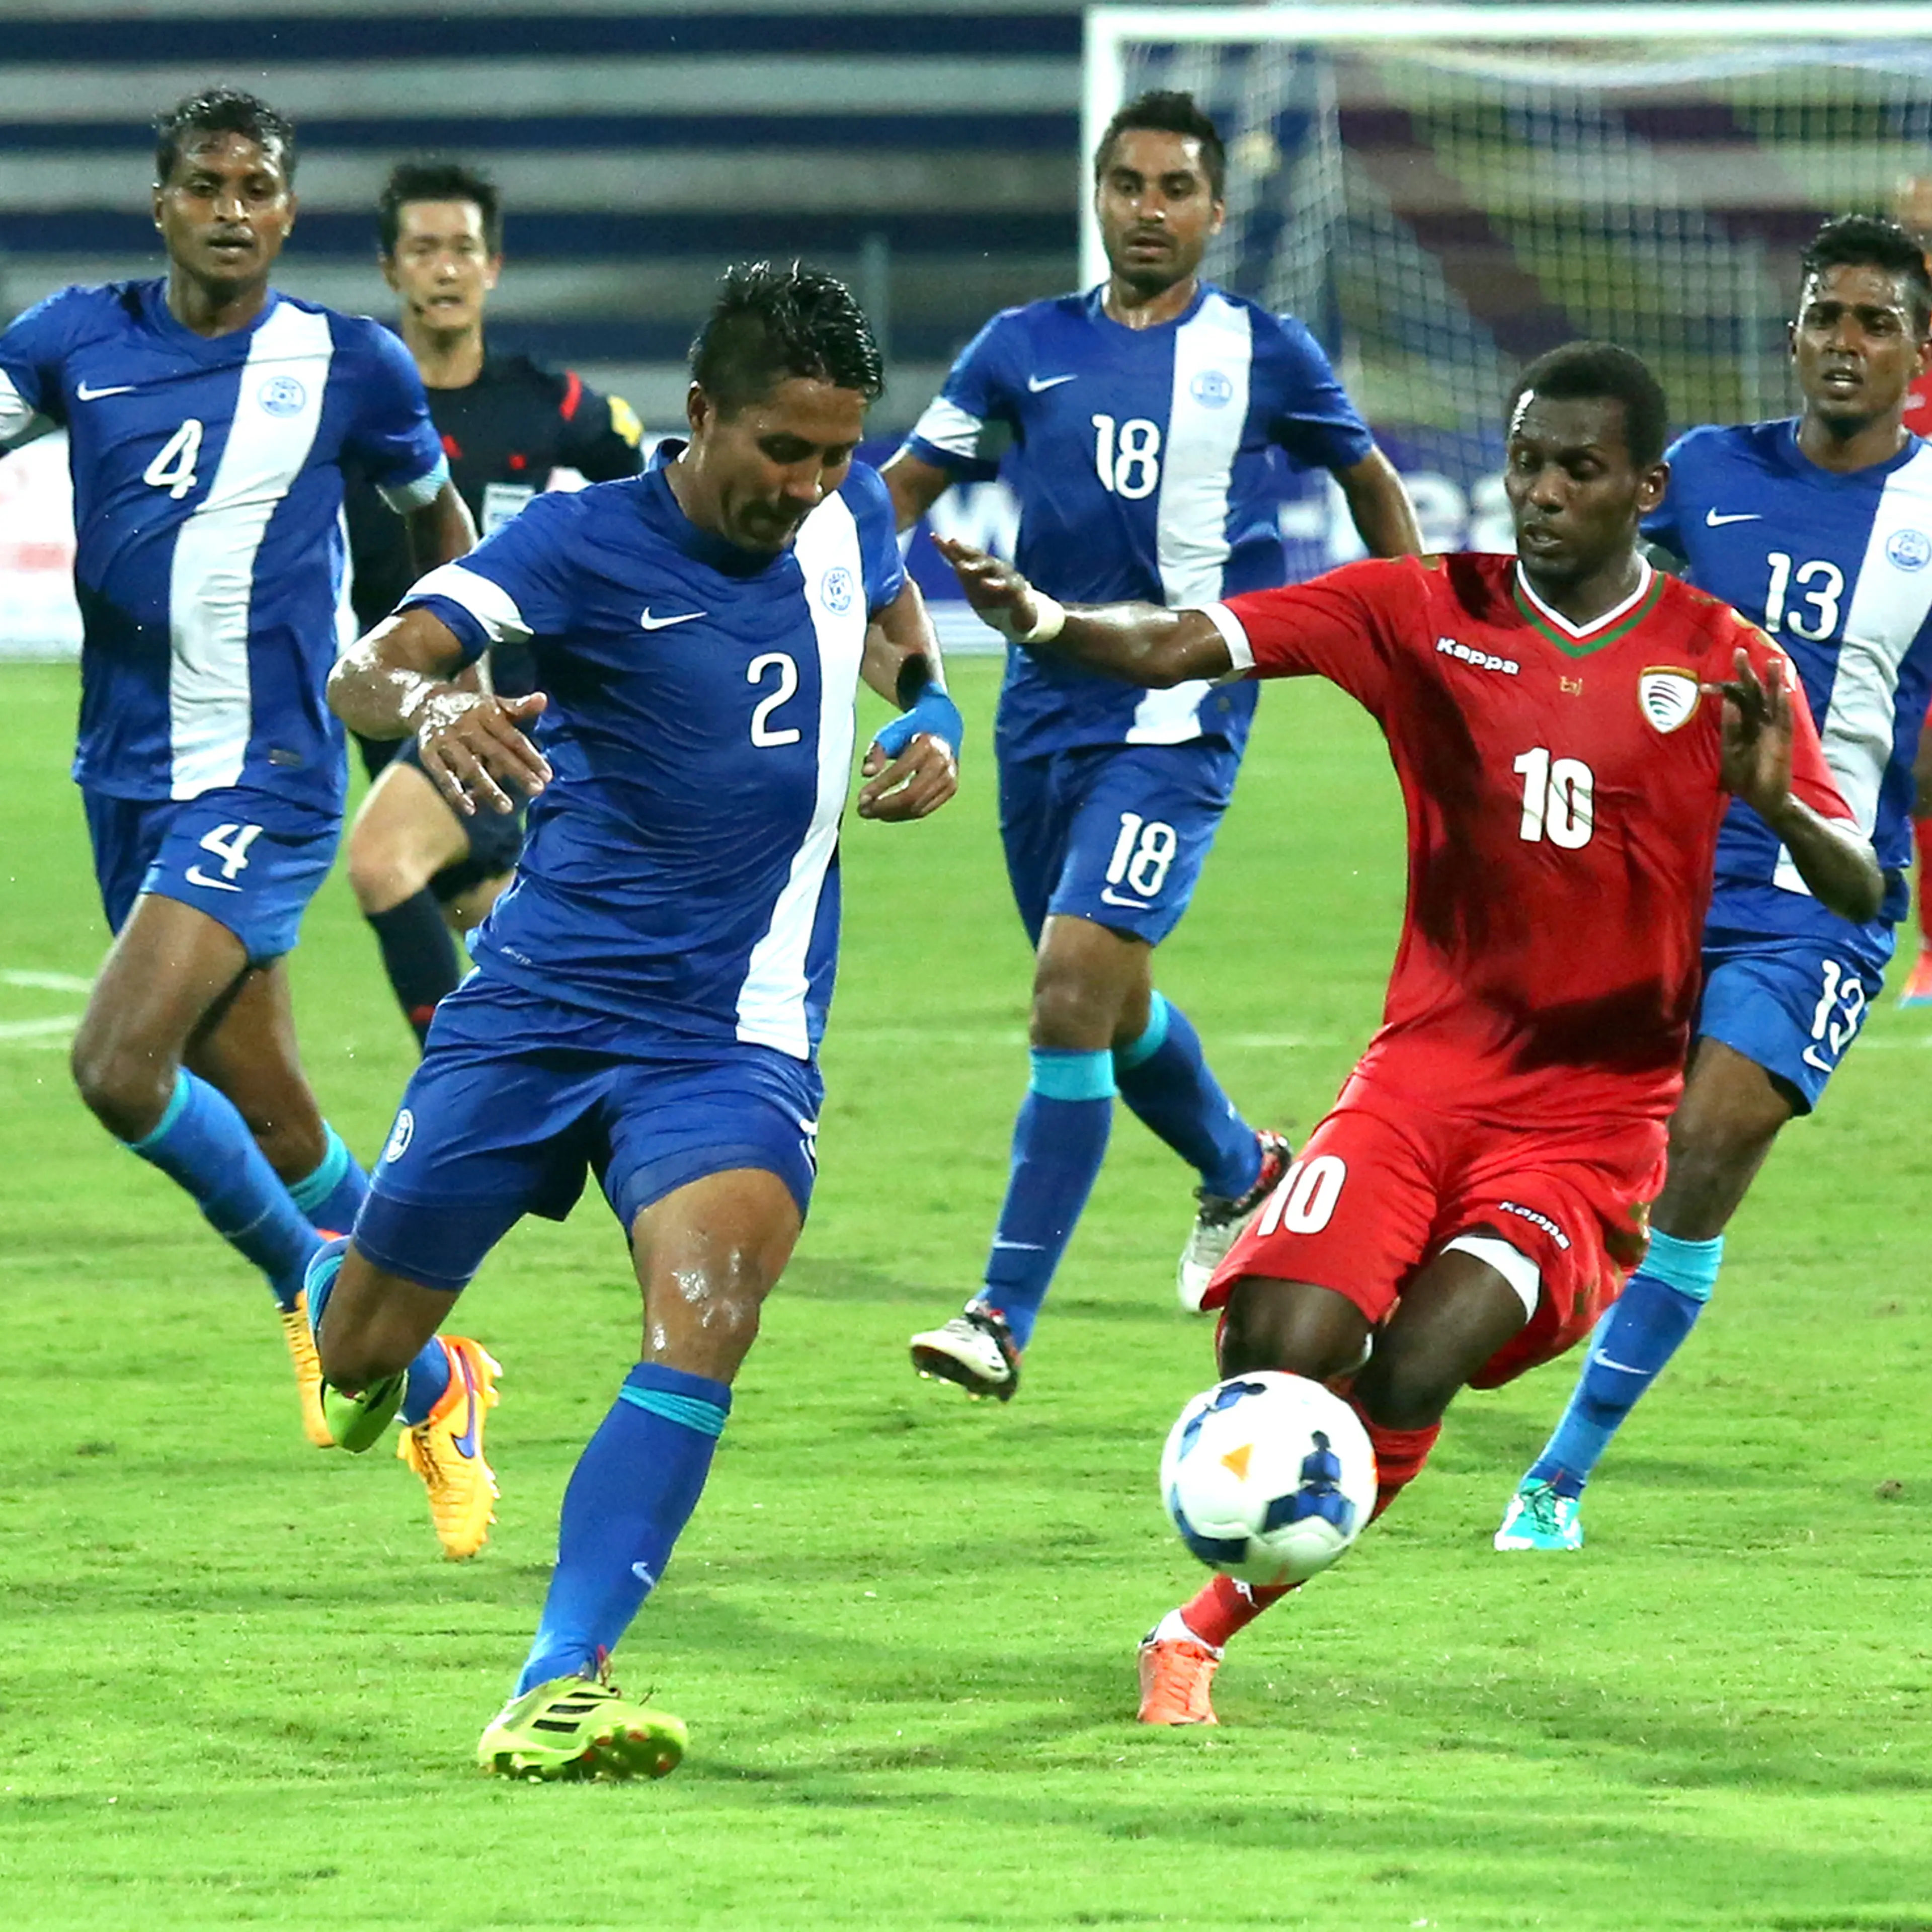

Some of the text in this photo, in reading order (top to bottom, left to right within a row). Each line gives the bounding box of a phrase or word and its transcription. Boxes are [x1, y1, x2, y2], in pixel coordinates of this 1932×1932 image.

[143, 419, 202, 499] 4
[1091, 414, 1160, 499] 18
[1765, 552, 1844, 641] 13
[1435, 636, 1520, 675] Kappa
[747, 652, 800, 747] 2
[1513, 747, 1594, 849] 10
[199, 824, 264, 879] 4
[1106, 812, 1177, 897] 18
[1257, 1155, 1346, 1236] 10
